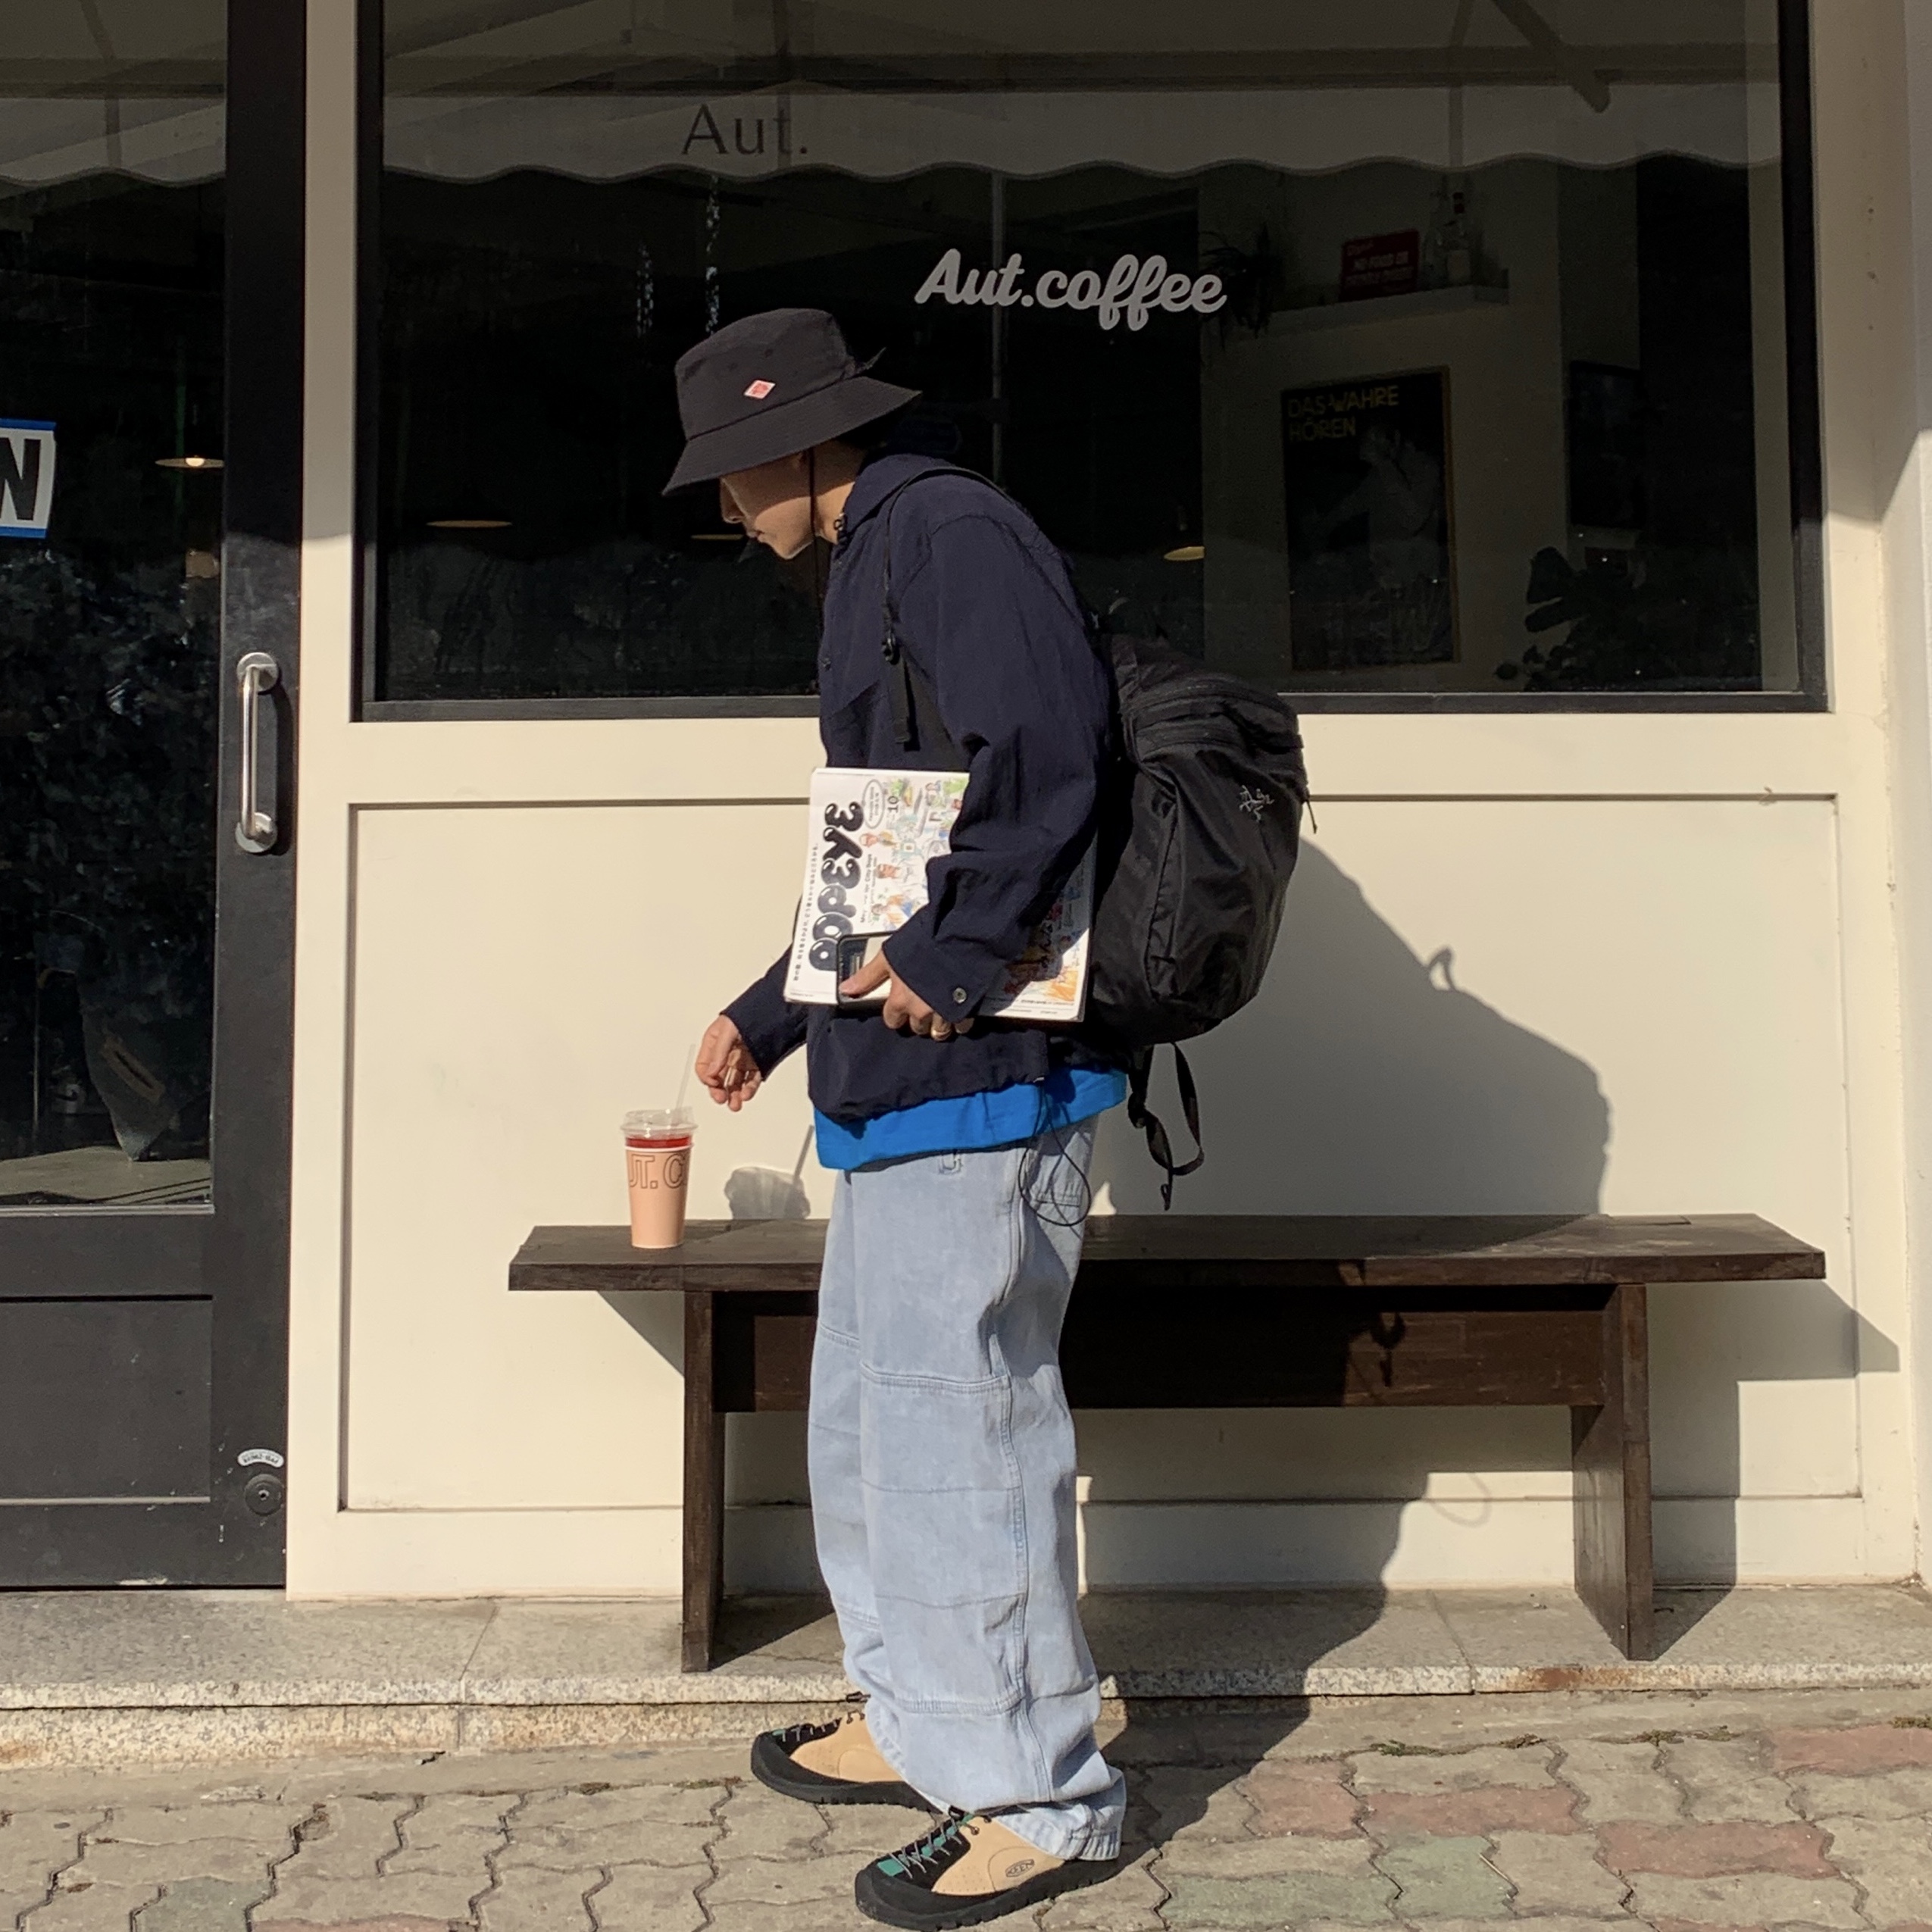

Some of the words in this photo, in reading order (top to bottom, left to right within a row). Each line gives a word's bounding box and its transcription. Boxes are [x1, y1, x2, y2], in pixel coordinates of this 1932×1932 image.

[681, 103, 808, 155] Aut.
[914, 248, 1227, 331] Aut.coffee
[1288, 395, 1327, 417] DAS
[1330, 385, 1399, 412] WAHRE
[808, 801, 864, 971] POPEYE
